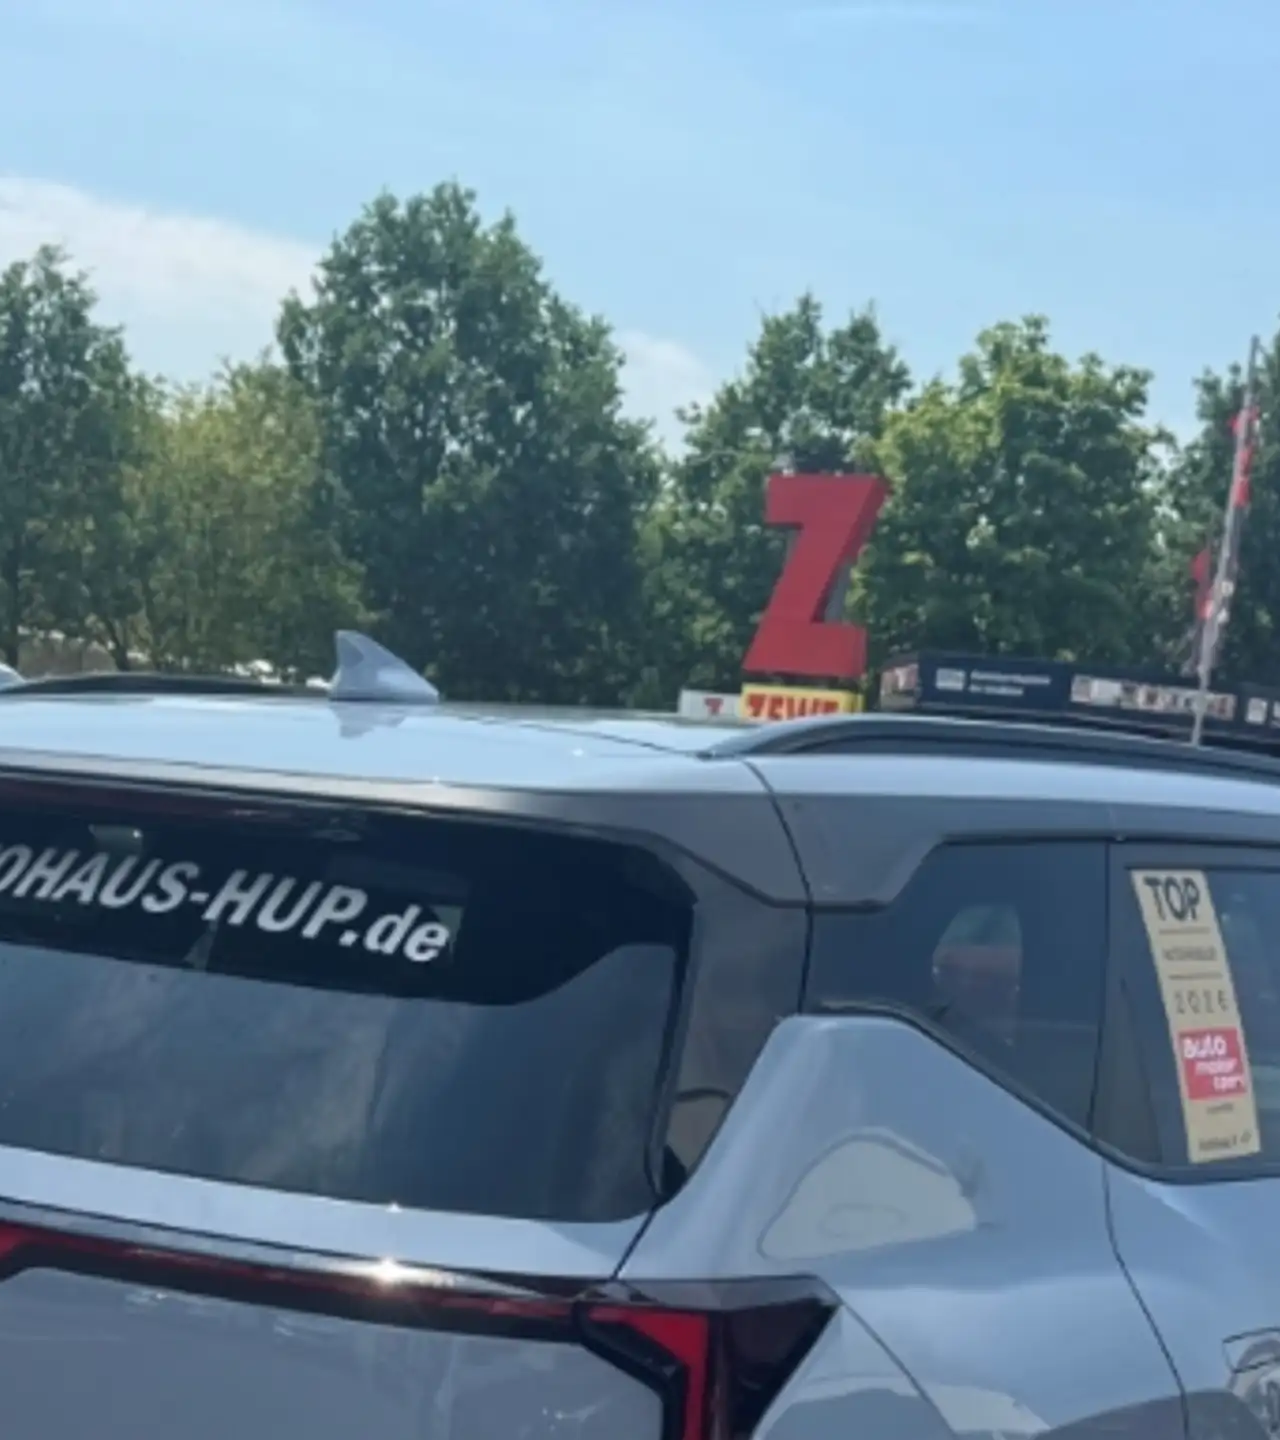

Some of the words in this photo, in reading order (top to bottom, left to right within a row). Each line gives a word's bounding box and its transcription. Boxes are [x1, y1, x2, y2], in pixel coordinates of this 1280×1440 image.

[742, 473, 892, 677] Z
[1143, 876, 1200, 921] TOP
[1183, 1033, 1228, 1058] auto
